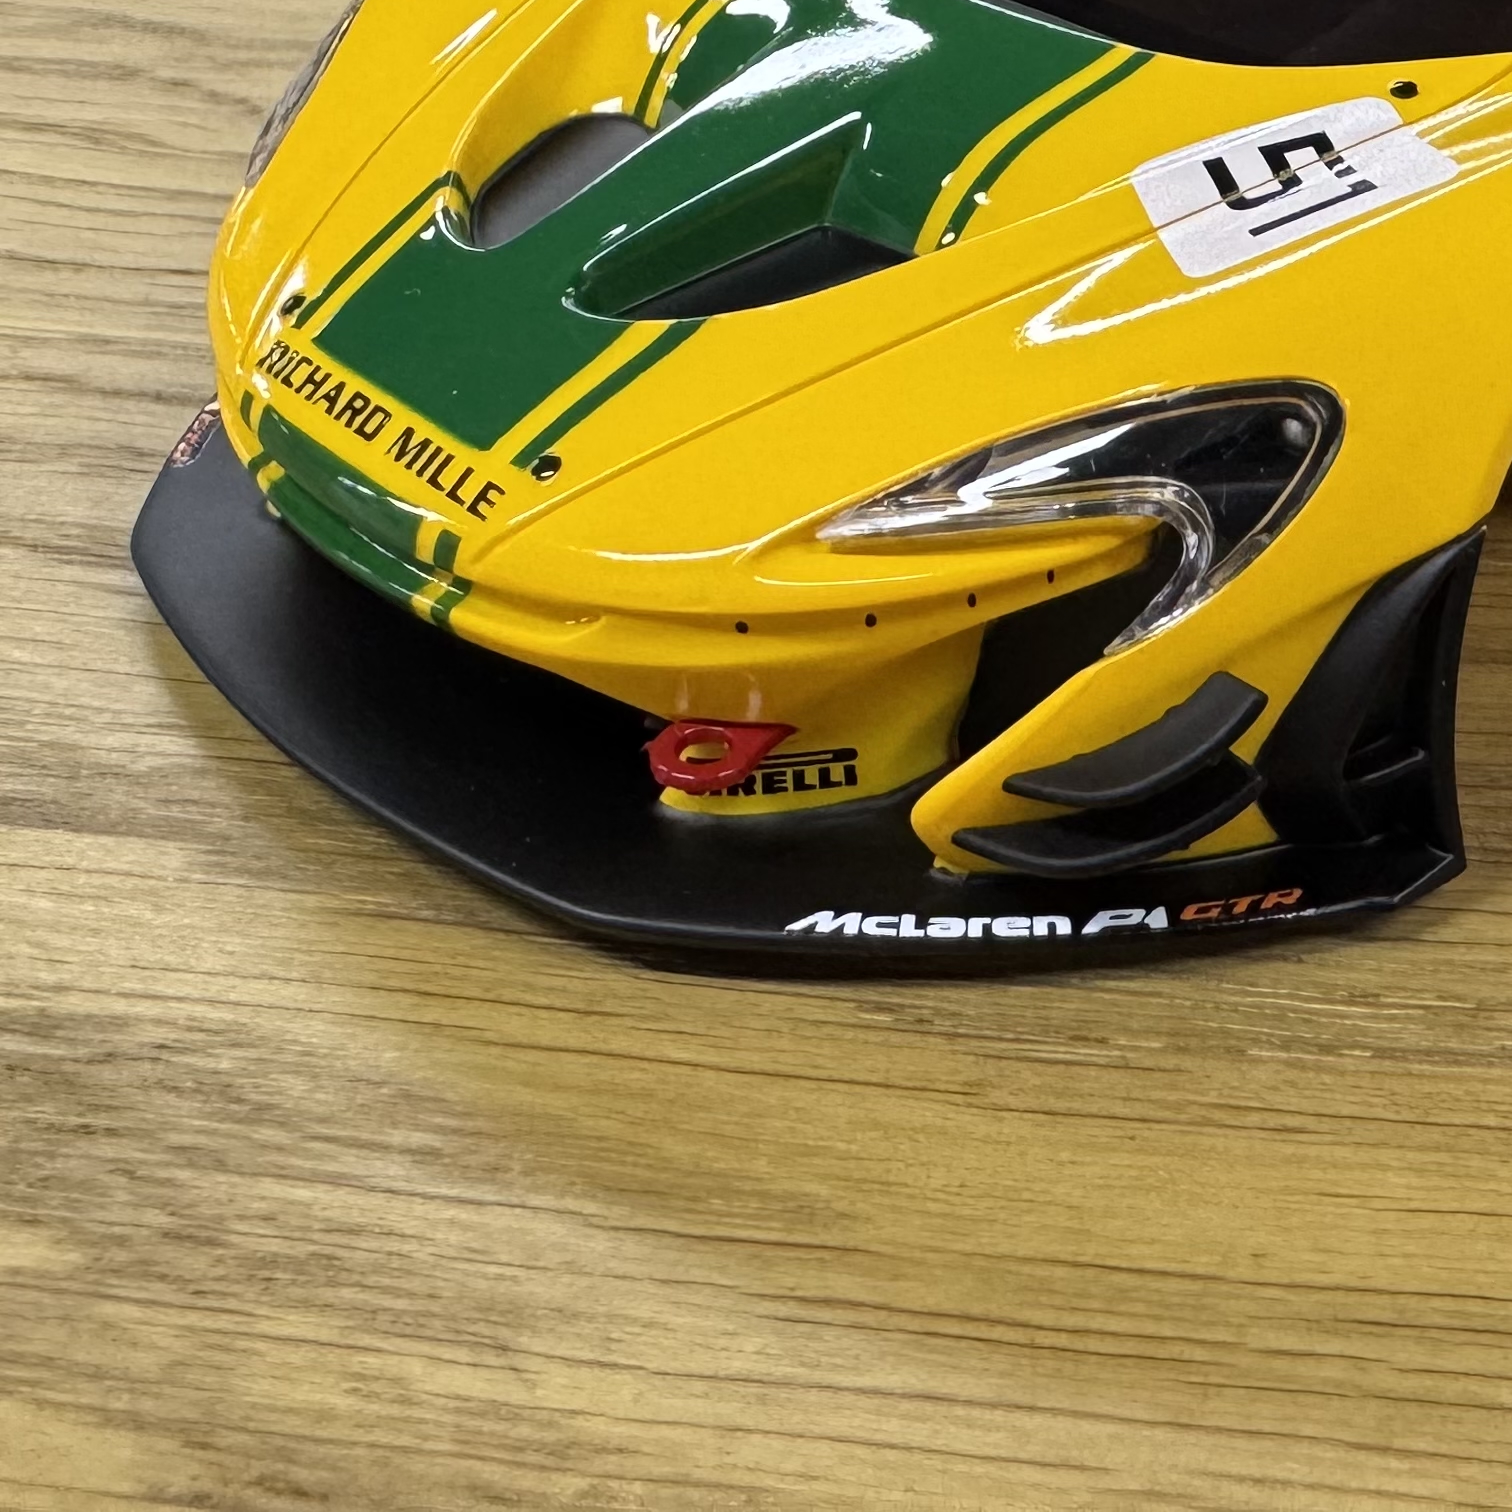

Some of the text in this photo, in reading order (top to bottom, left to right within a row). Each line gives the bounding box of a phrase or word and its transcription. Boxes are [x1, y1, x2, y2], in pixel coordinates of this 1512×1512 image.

[256, 339, 392, 443] RICHARD
[385, 426, 506, 522] MILLE
[700, 746, 858, 797] RELLI
[783, 888, 1302, 938] McLaren P1 GTR
